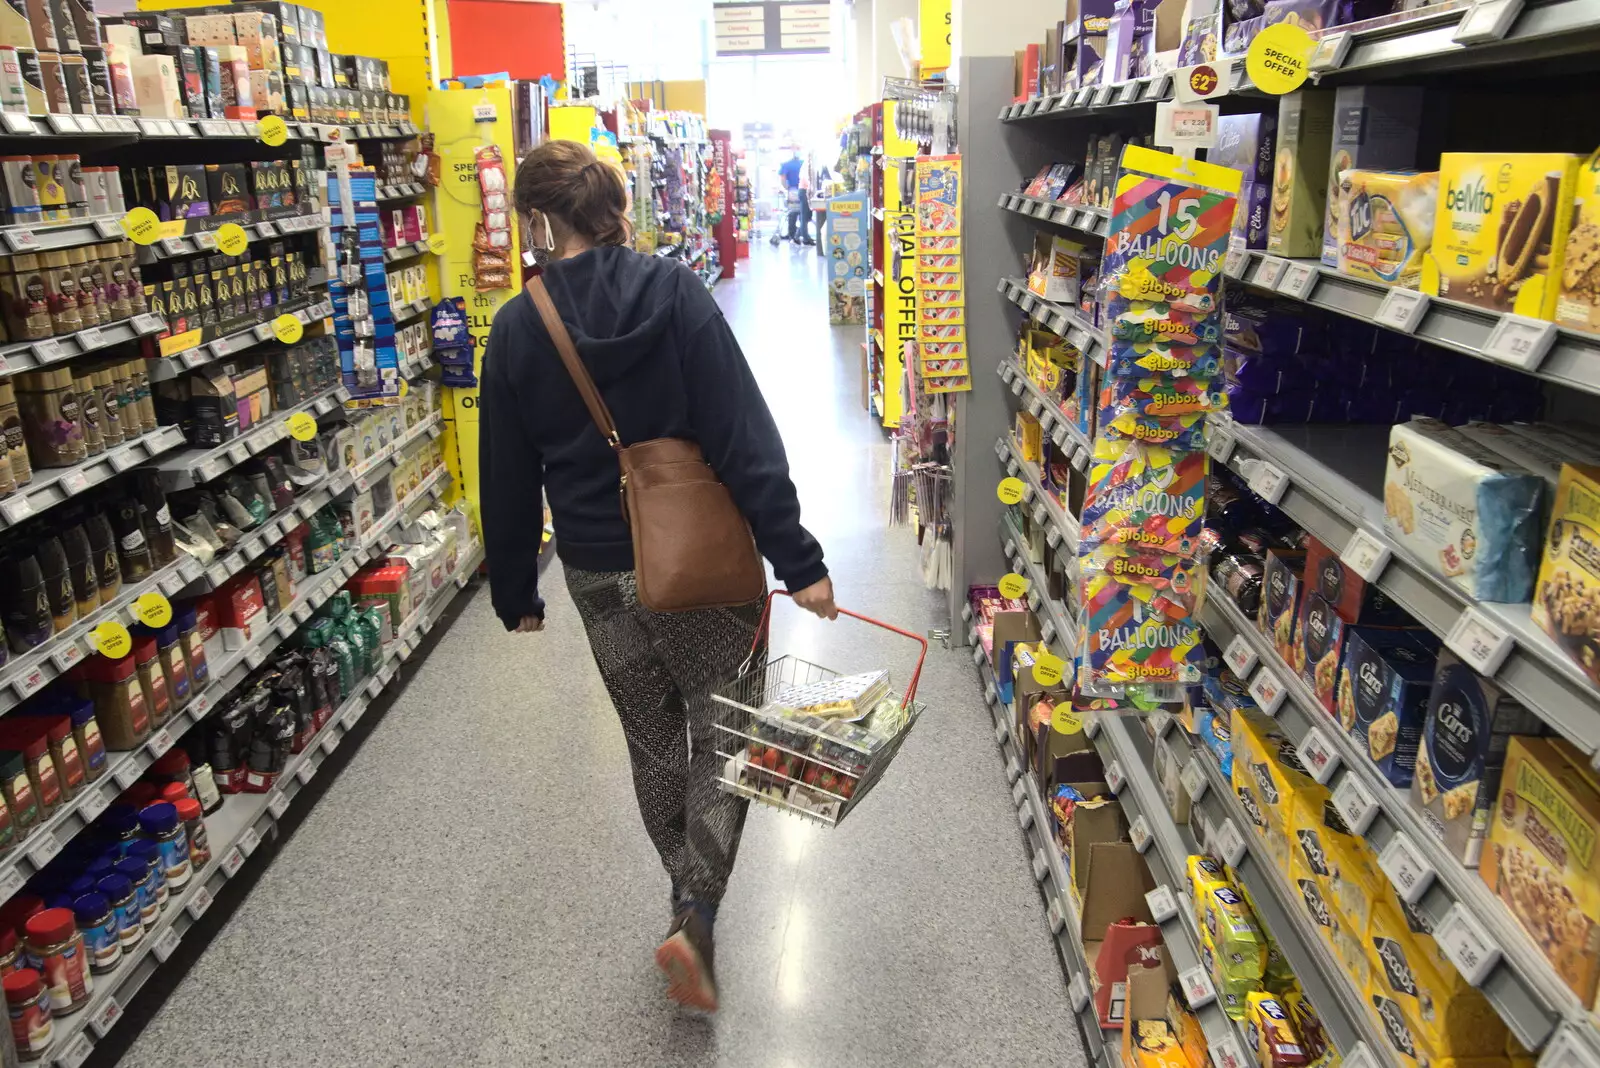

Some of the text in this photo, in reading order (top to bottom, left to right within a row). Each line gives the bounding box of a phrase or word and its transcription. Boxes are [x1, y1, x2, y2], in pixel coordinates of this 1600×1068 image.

[1264, 47, 1302, 70] SPECIAL
[1264, 59, 1295, 78] OFFER
[263, 125, 282, 136] SPECIAL
[267, 131, 282, 140] OFFER
[453, 163, 478, 173] SPEC
[458, 173, 480, 183] OFF
[1157, 190, 1200, 240] 15
[131, 218, 152, 231] SPECIAL
[136, 226, 153, 237] OFFER
[222, 234, 240, 245] SPECIAL
[226, 239, 241, 249] OFFER
[1115, 230, 1219, 274] BALLOONS
[459, 274, 476, 287] Fo
[1139, 278, 1186, 298] globos
[473, 294, 497, 308] the
[1143, 318, 1191, 335] globos
[1148, 356, 1192, 371] globos
[1153, 393, 1198, 409] globos
[1135, 424, 1180, 440] globos
[1002, 487, 1020, 496] SPECIAL
[1116, 526, 1165, 545] globos
[1112, 559, 1160, 577] globos
[143, 603, 164, 617] SPECIAL
[147, 609, 164, 621] OFFER
[1308, 610, 1328, 639] Carrs
[101, 633, 122, 647] SPECIAL
[1099, 625, 1195, 651] BALLOONS
[106, 639, 123, 652] OFFER
[1039, 665, 1059, 675] SPECIAL
[1040, 669, 1056, 679] OFFER
[1126, 665, 1172, 680] globos
[1359, 662, 1384, 694] Carrs
[1059, 717, 1077, 727] OFFER
[1438, 703, 1473, 743] Carrs
